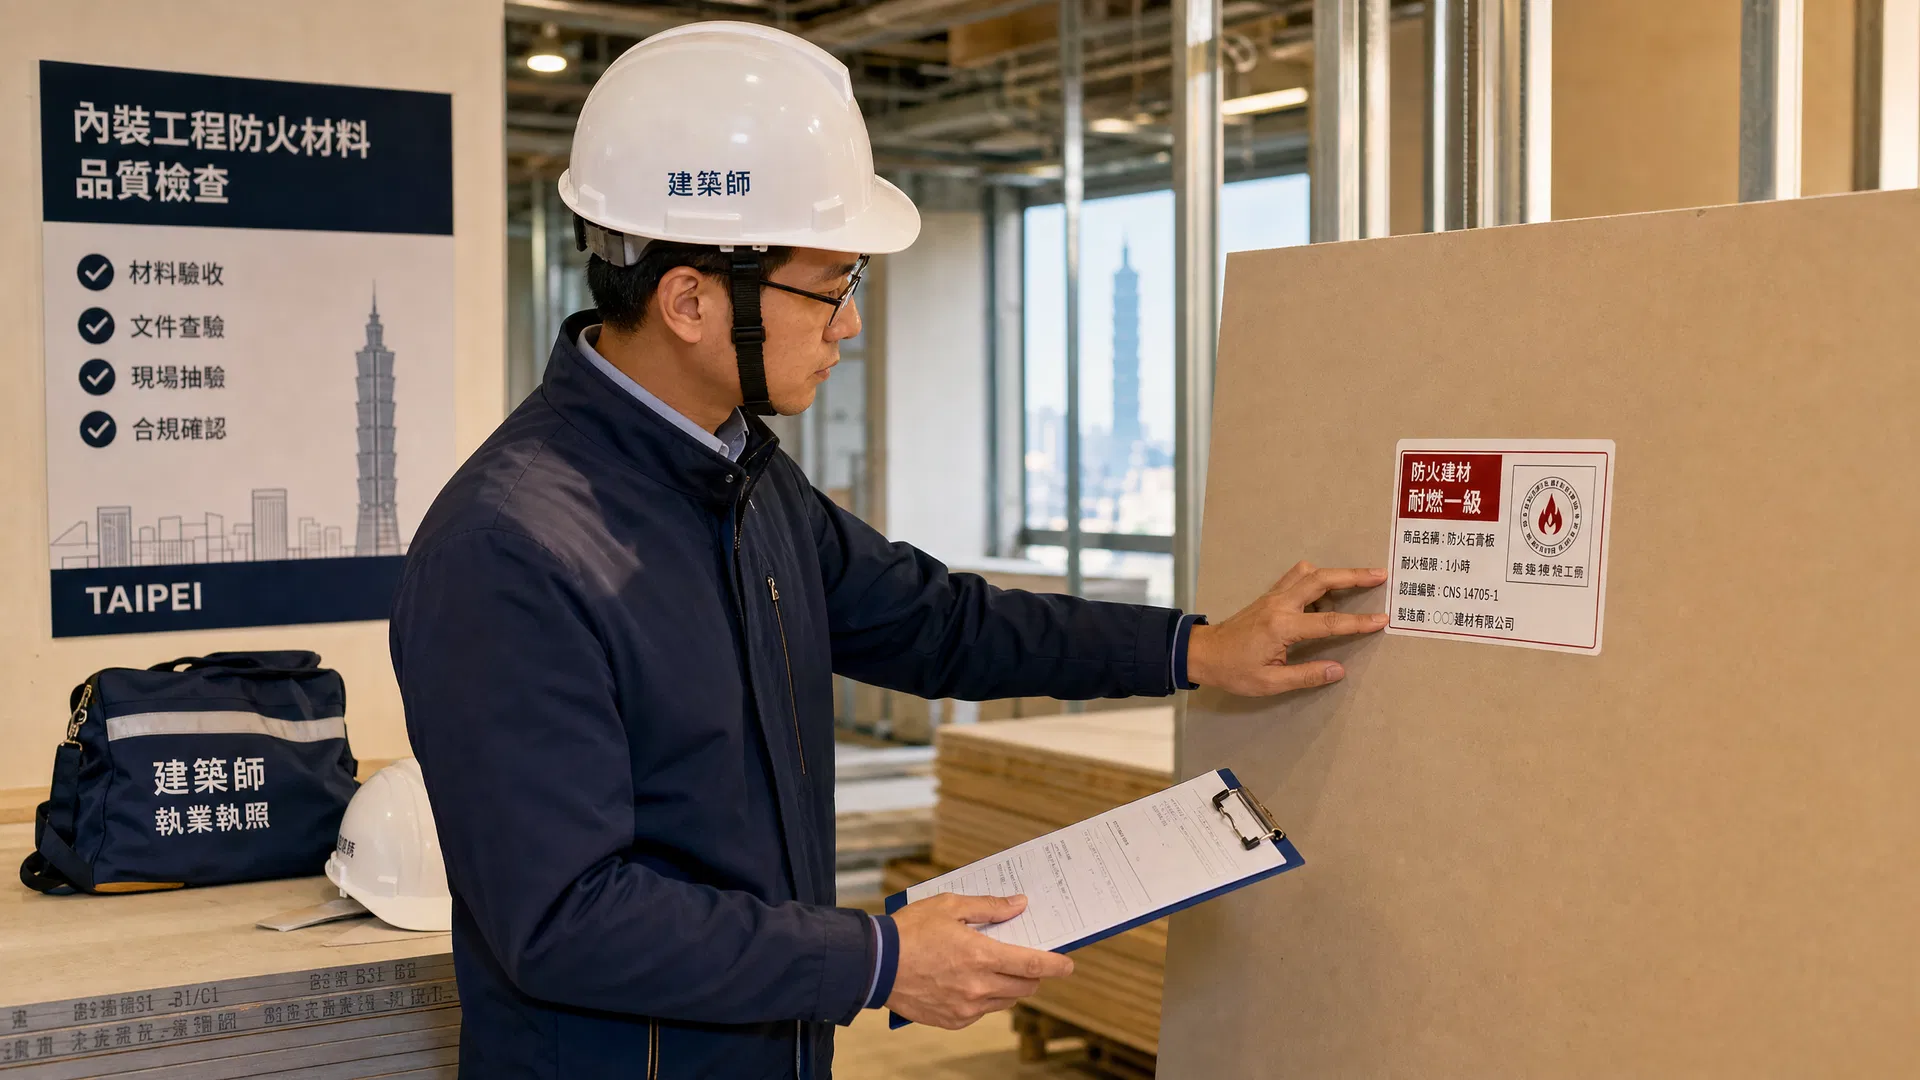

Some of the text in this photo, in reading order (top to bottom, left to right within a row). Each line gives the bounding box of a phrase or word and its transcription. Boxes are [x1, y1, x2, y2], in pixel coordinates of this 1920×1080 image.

[74, 101, 370, 159] 內裝工程防火材料
[76, 158, 229, 204] 品質檢查
[667, 170, 750, 196] 建築師
[129, 260, 224, 286] 材料驗收
[130, 314, 225, 339] 文件查驗
[132, 365, 225, 389] 現場抽驗
[132, 416, 227, 441] 合規確認
[1411, 461, 1472, 483] 防火建材
[1408, 488, 1482, 515] 耐燃一級
[85, 581, 202, 615] TAIPEI
[1464, 587, 1499, 602] 14705-1
[153, 756, 266, 796] 建築師
[155, 801, 271, 836] 執業執照
